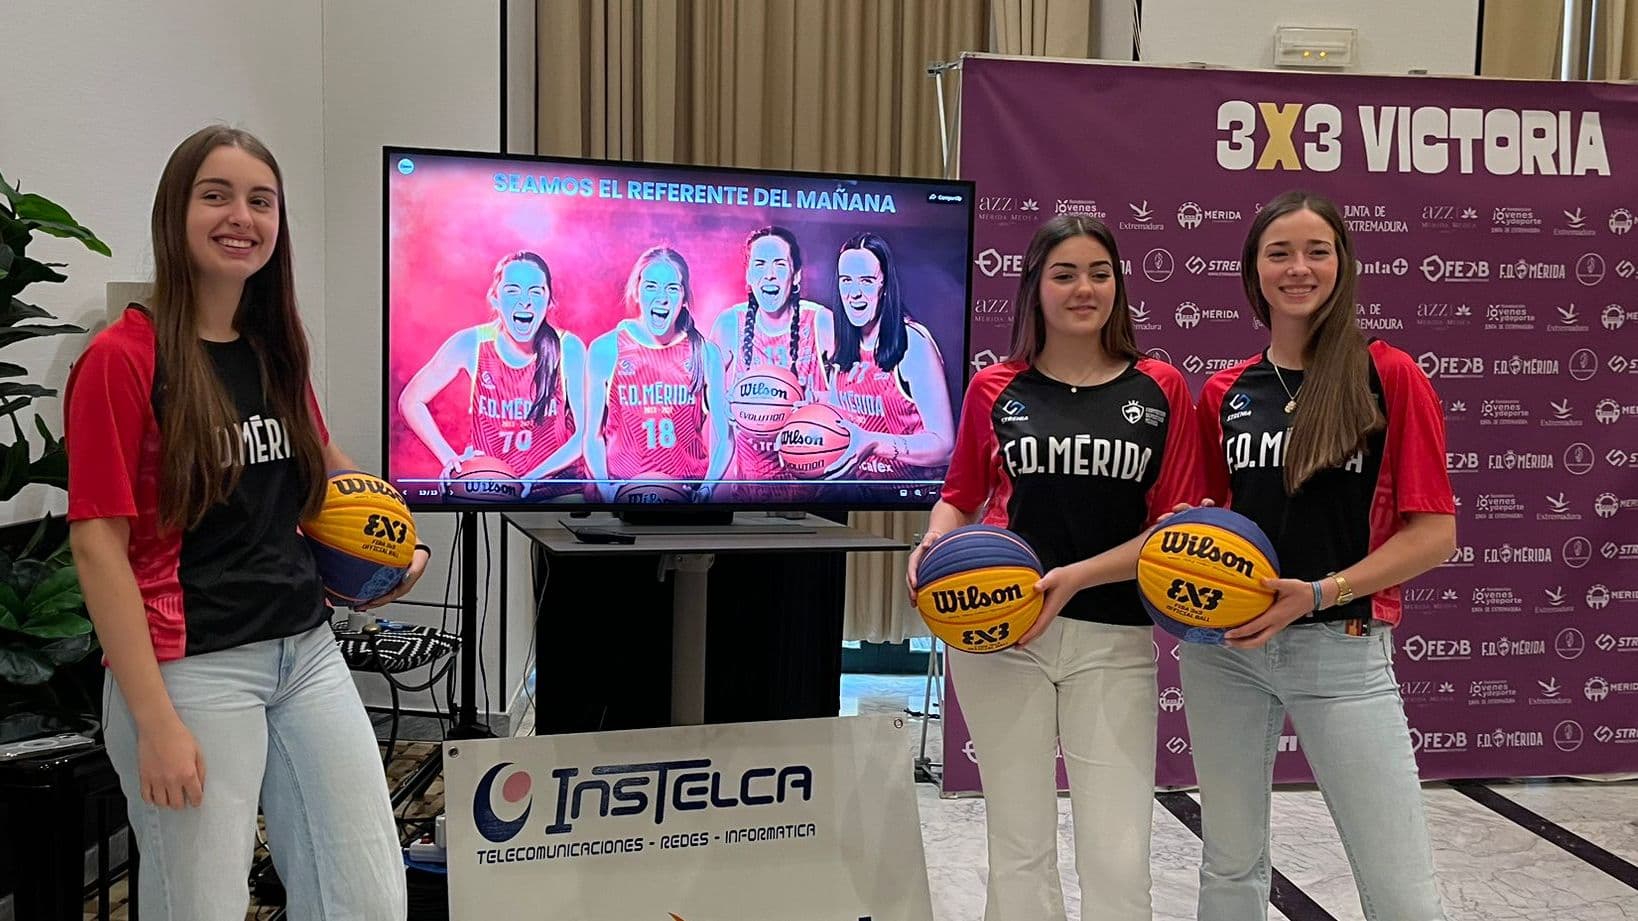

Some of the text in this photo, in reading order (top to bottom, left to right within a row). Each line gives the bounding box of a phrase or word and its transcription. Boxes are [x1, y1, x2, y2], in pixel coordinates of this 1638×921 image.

[1216, 100, 1611, 176] 3X3 VICTORIA
[493, 172, 897, 213] SEAMOS EL REFERENTE DEL MAÑANA
[1343, 205, 1386, 218] JUNTA DE
[1119, 221, 1165, 231] Extremadura
[1003, 255, 1023, 272] FE
[1370, 304, 1381, 315] DE
[740, 382, 788, 400] Wilson
[499, 429, 532, 454] 70
[642, 418, 677, 449] 18
[781, 430, 824, 446] Wilson
[1517, 453, 1554, 469] MÉRIDA
[1160, 530, 1255, 579] Wilson
[1513, 547, 1552, 563] MÉRIDA
[931, 583, 1024, 614] Wilson
[476, 837, 644, 865] TELECOMUNICACIONES
[660, 832, 709, 849] REDES
[725, 823, 816, 844] INFORMATICA
